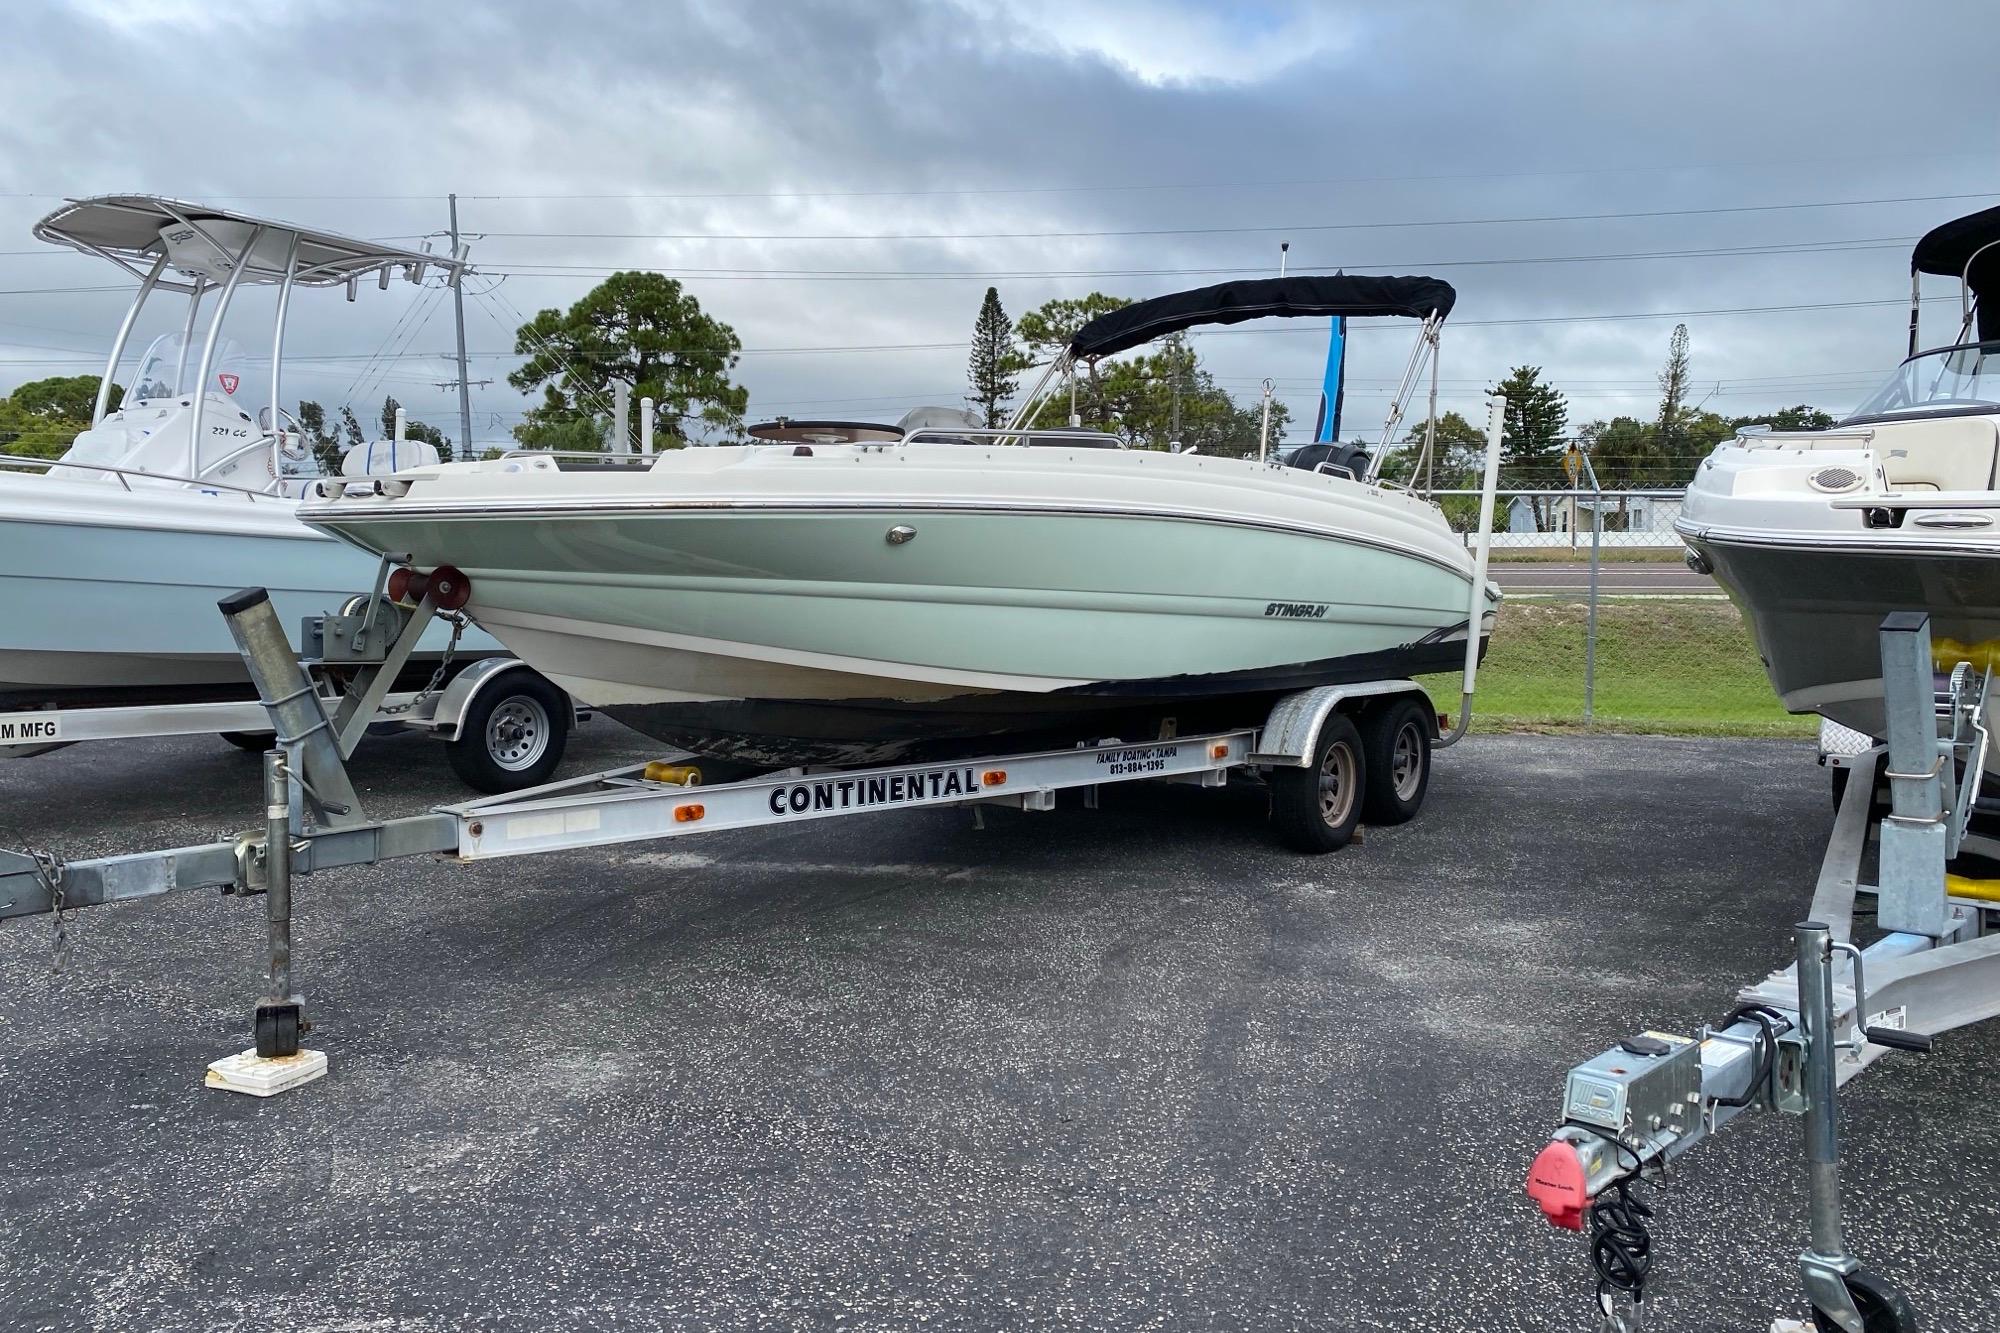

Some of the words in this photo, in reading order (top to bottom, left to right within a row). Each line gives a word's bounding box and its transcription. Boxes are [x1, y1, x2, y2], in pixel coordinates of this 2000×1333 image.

[212, 426, 229, 436] 221
[1264, 603, 1329, 618] STINGRAY
[0, 723, 15, 739] M
[20, 721, 56, 738] MFG
[1096, 751, 1121, 764] FAMILY
[1156, 747, 1177, 758] TAMPA
[1110, 760, 1164, 774] 813-884-1395
[769, 768, 980, 816] CONTINENTAL
